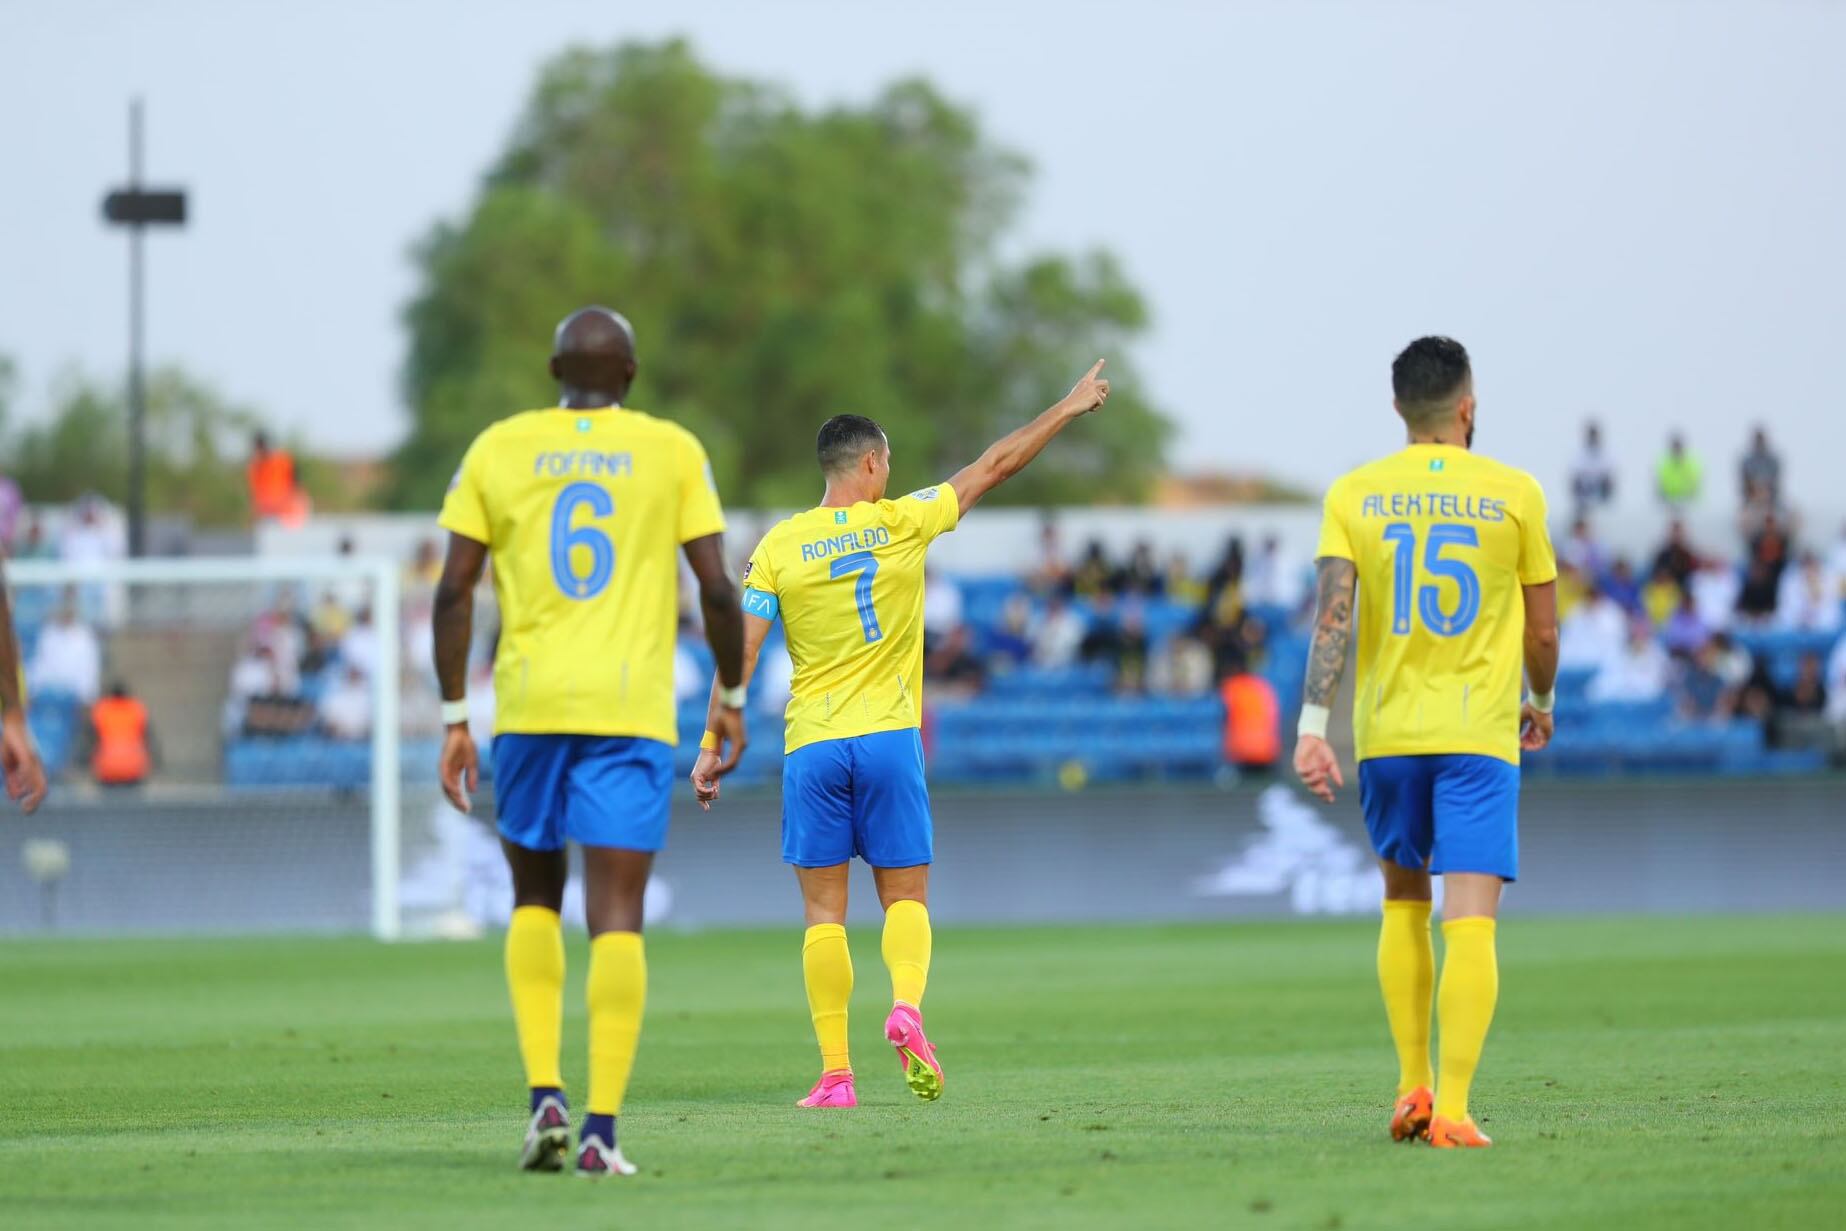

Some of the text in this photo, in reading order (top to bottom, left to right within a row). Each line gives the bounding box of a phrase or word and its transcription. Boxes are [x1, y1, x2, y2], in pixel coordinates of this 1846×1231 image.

[534, 451, 633, 477] FOFANA
[550, 480, 615, 601] 6
[801, 527, 890, 562] RONALDO
[1382, 522, 1480, 637] 15
[829, 551, 884, 643] 7
